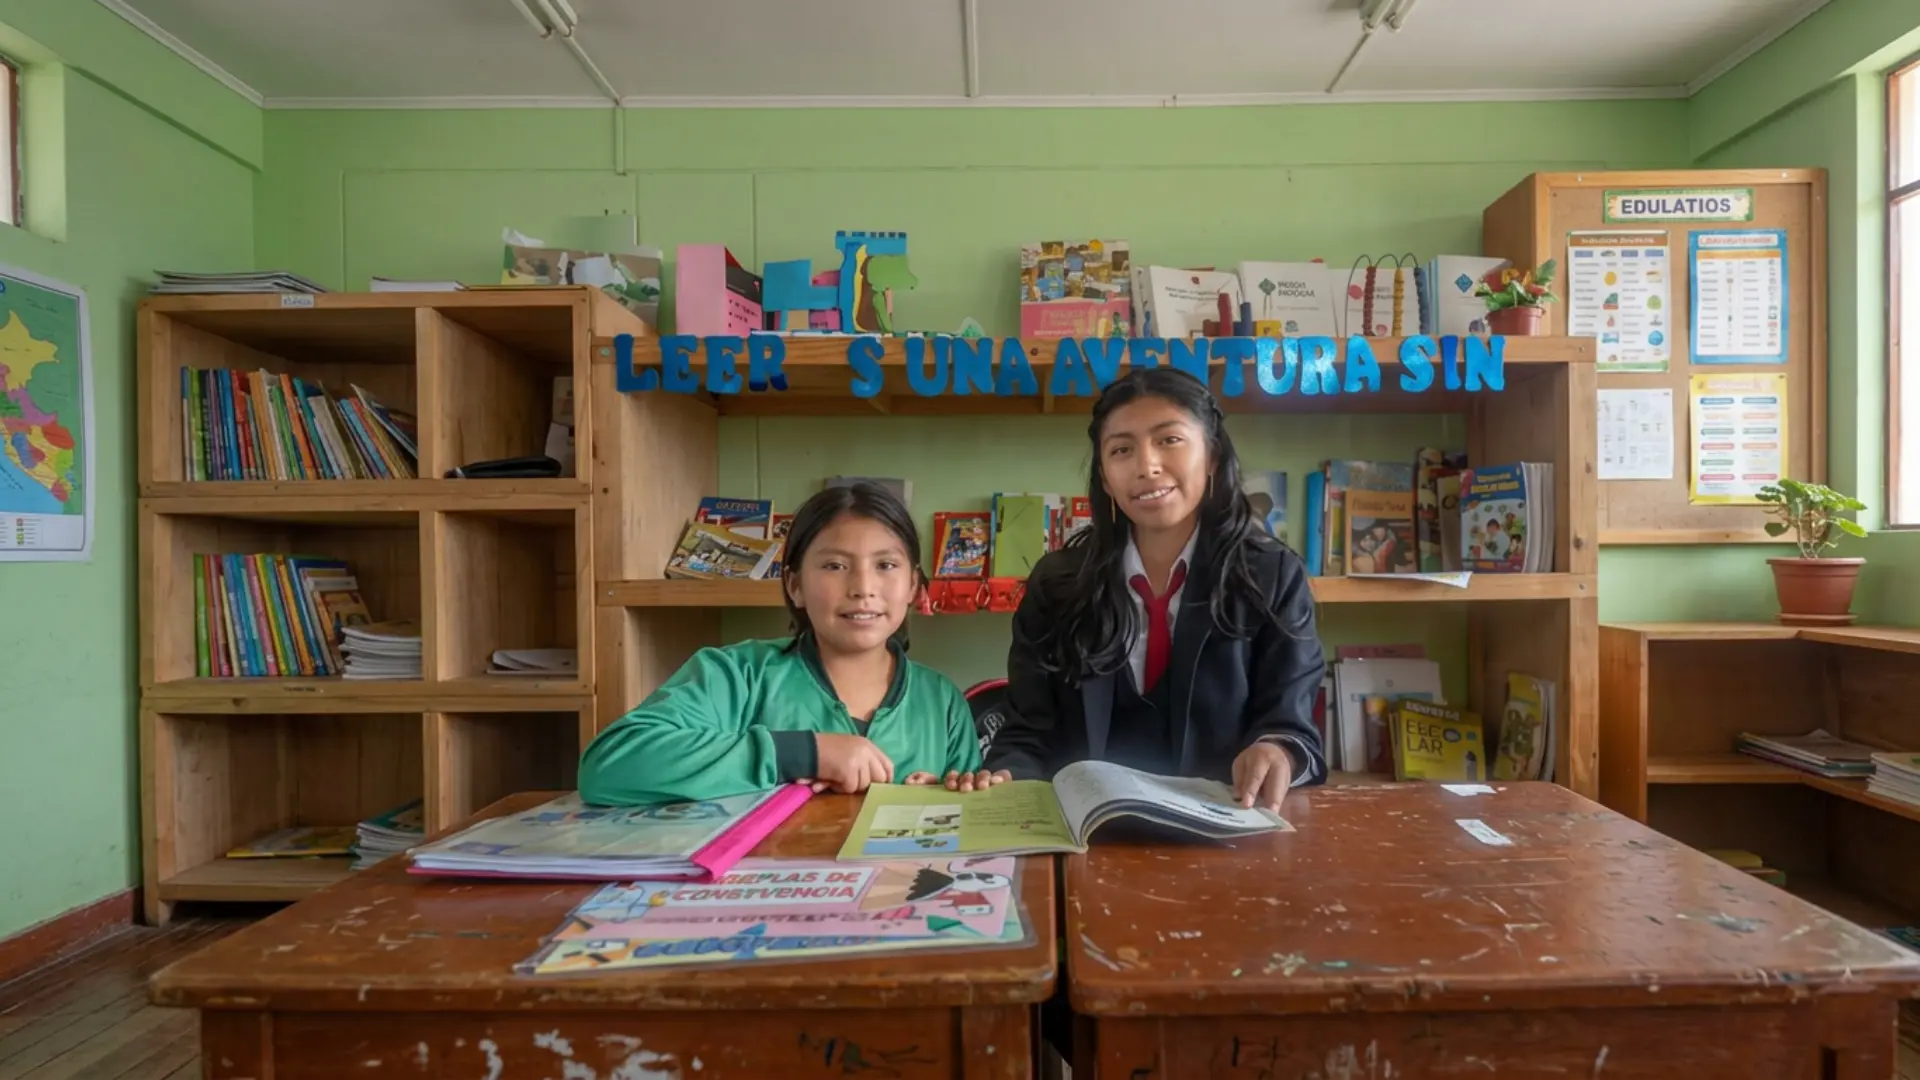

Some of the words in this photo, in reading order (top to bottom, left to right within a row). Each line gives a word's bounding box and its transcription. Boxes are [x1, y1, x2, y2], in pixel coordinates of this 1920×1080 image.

[1621, 197, 1731, 215] EDULATIOS
[614, 333, 788, 394] LEER
[847, 336, 885, 398] S
[905, 336, 1039, 398] UNA
[1049, 334, 1381, 397] AVENTURA
[1400, 334, 1506, 392] SIN
[824, 871, 862, 884] DE
